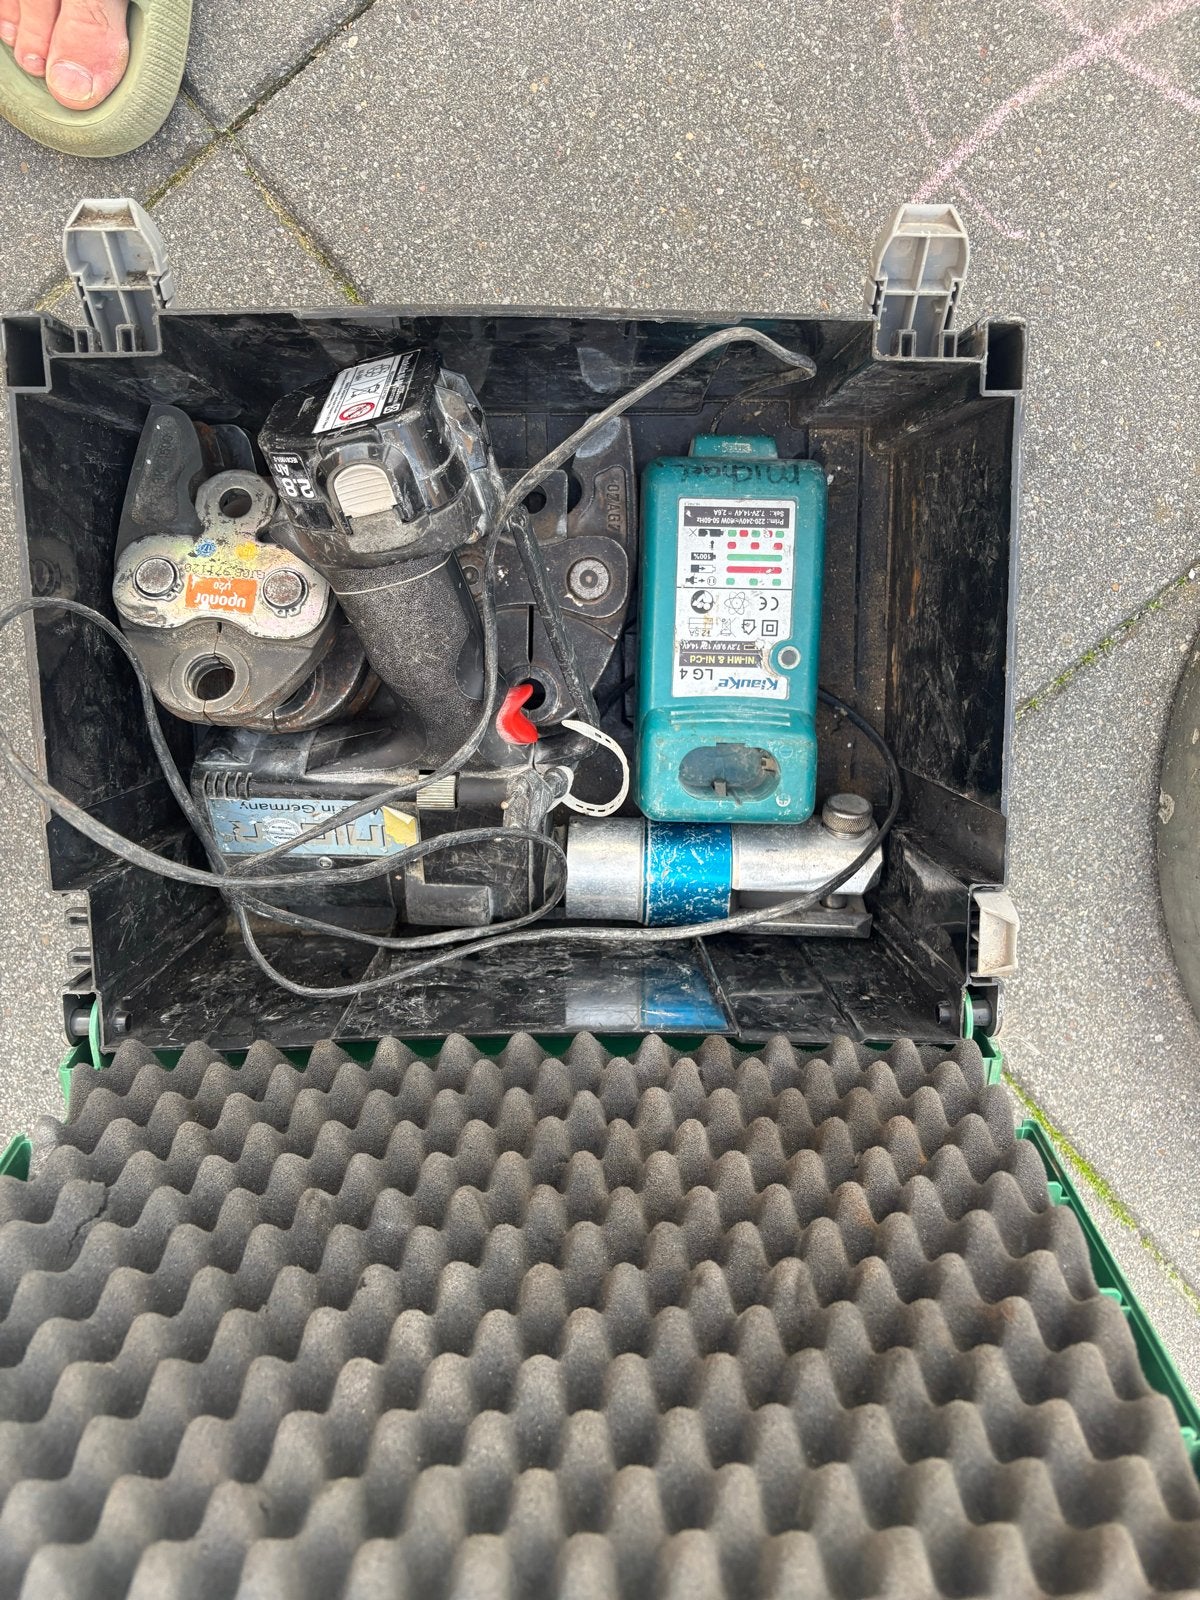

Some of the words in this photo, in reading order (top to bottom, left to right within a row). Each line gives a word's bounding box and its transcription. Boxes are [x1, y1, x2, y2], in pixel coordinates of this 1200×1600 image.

[274, 463, 289, 476] Ah
[282, 477, 313, 498] 2.8
[193, 592, 246, 608] uponor
[690, 655, 715, 664] Ni-Cd
[679, 668, 688, 679] 4
[693, 668, 713, 680] LG
[238, 801, 316, 814] Germany
[321, 804, 335, 813] in
